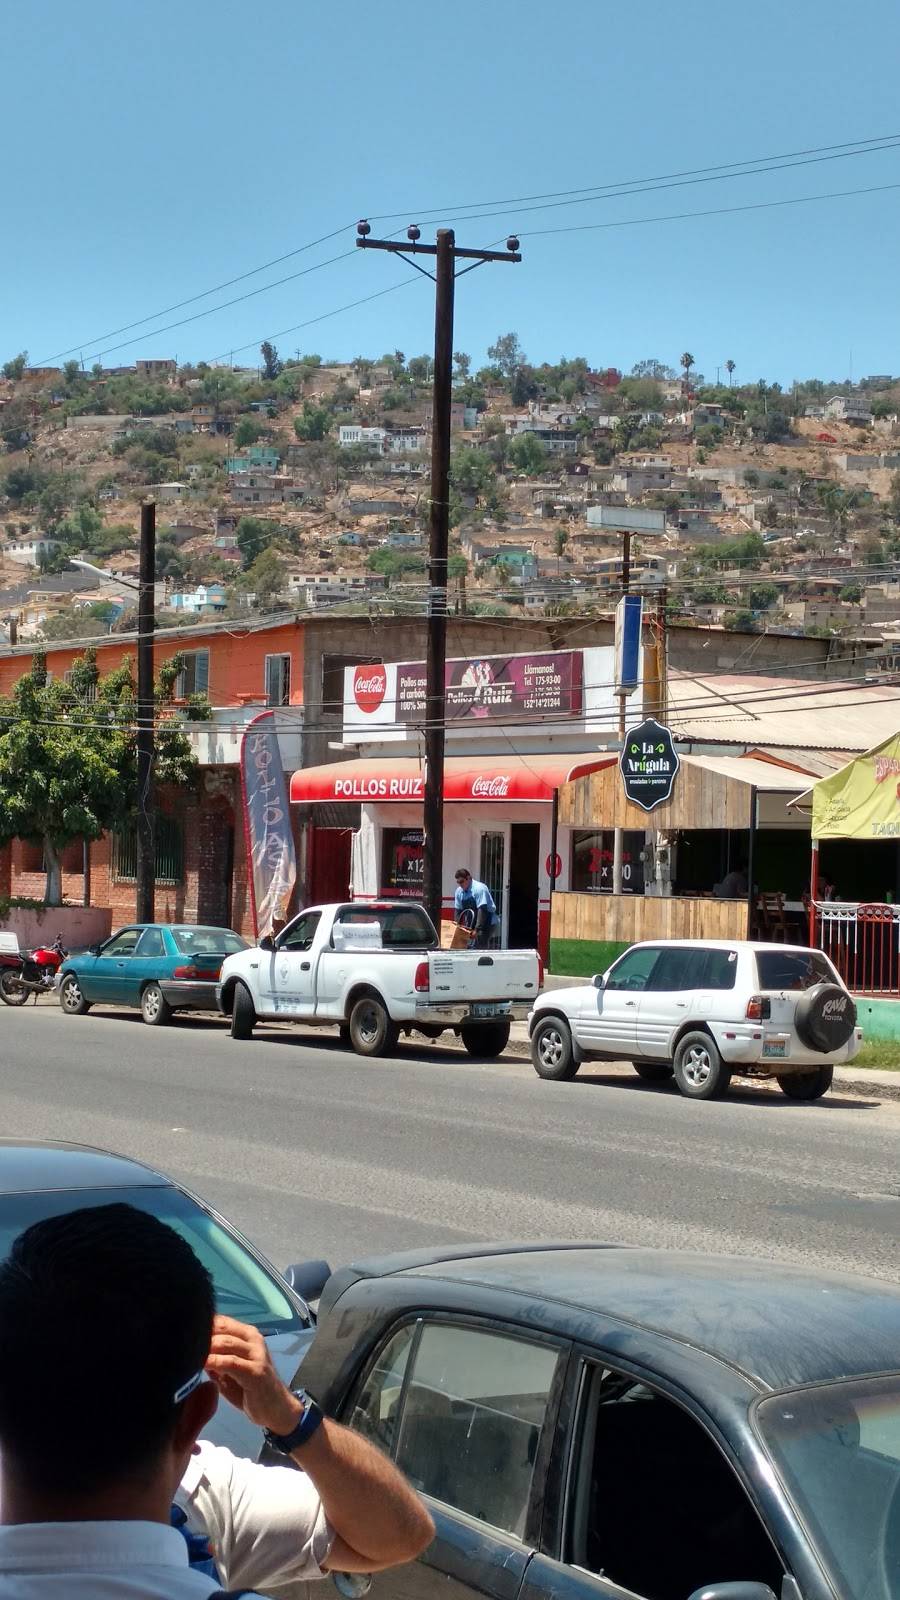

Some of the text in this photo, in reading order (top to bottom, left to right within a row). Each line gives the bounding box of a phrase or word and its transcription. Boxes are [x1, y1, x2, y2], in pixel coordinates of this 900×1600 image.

[400, 677, 416, 688] Pollos
[483, 686, 512, 704] Ruiz
[642, 742, 654, 754] La
[627, 755, 670, 774] Arúgula
[335, 778, 422, 796] POLLOS RUIZ
[824, 1014, 843, 1022] TOYOTA
